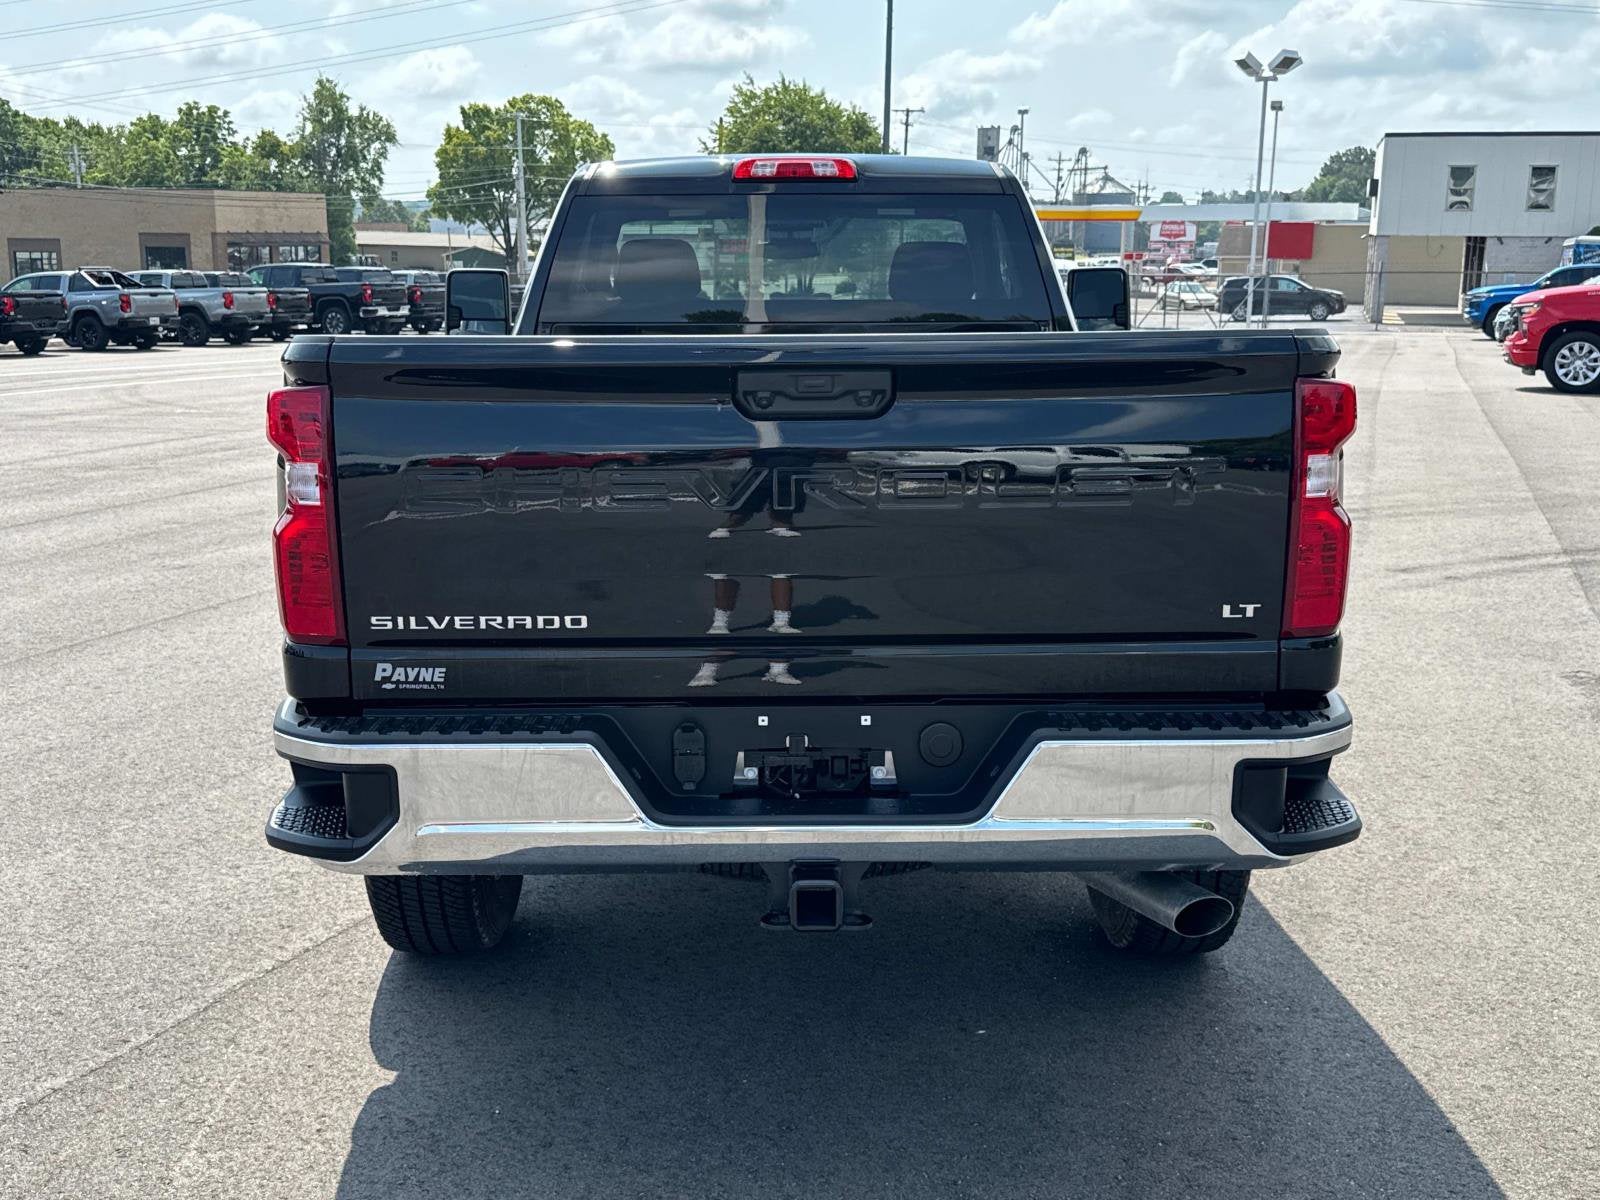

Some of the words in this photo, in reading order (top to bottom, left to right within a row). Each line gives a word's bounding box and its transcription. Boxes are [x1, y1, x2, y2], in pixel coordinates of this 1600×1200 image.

[404, 458, 1226, 512] CHEVROLET
[1222, 603, 1262, 618] LT
[370, 615, 589, 630] SILVERADO
[374, 662, 447, 682] PAYNE
